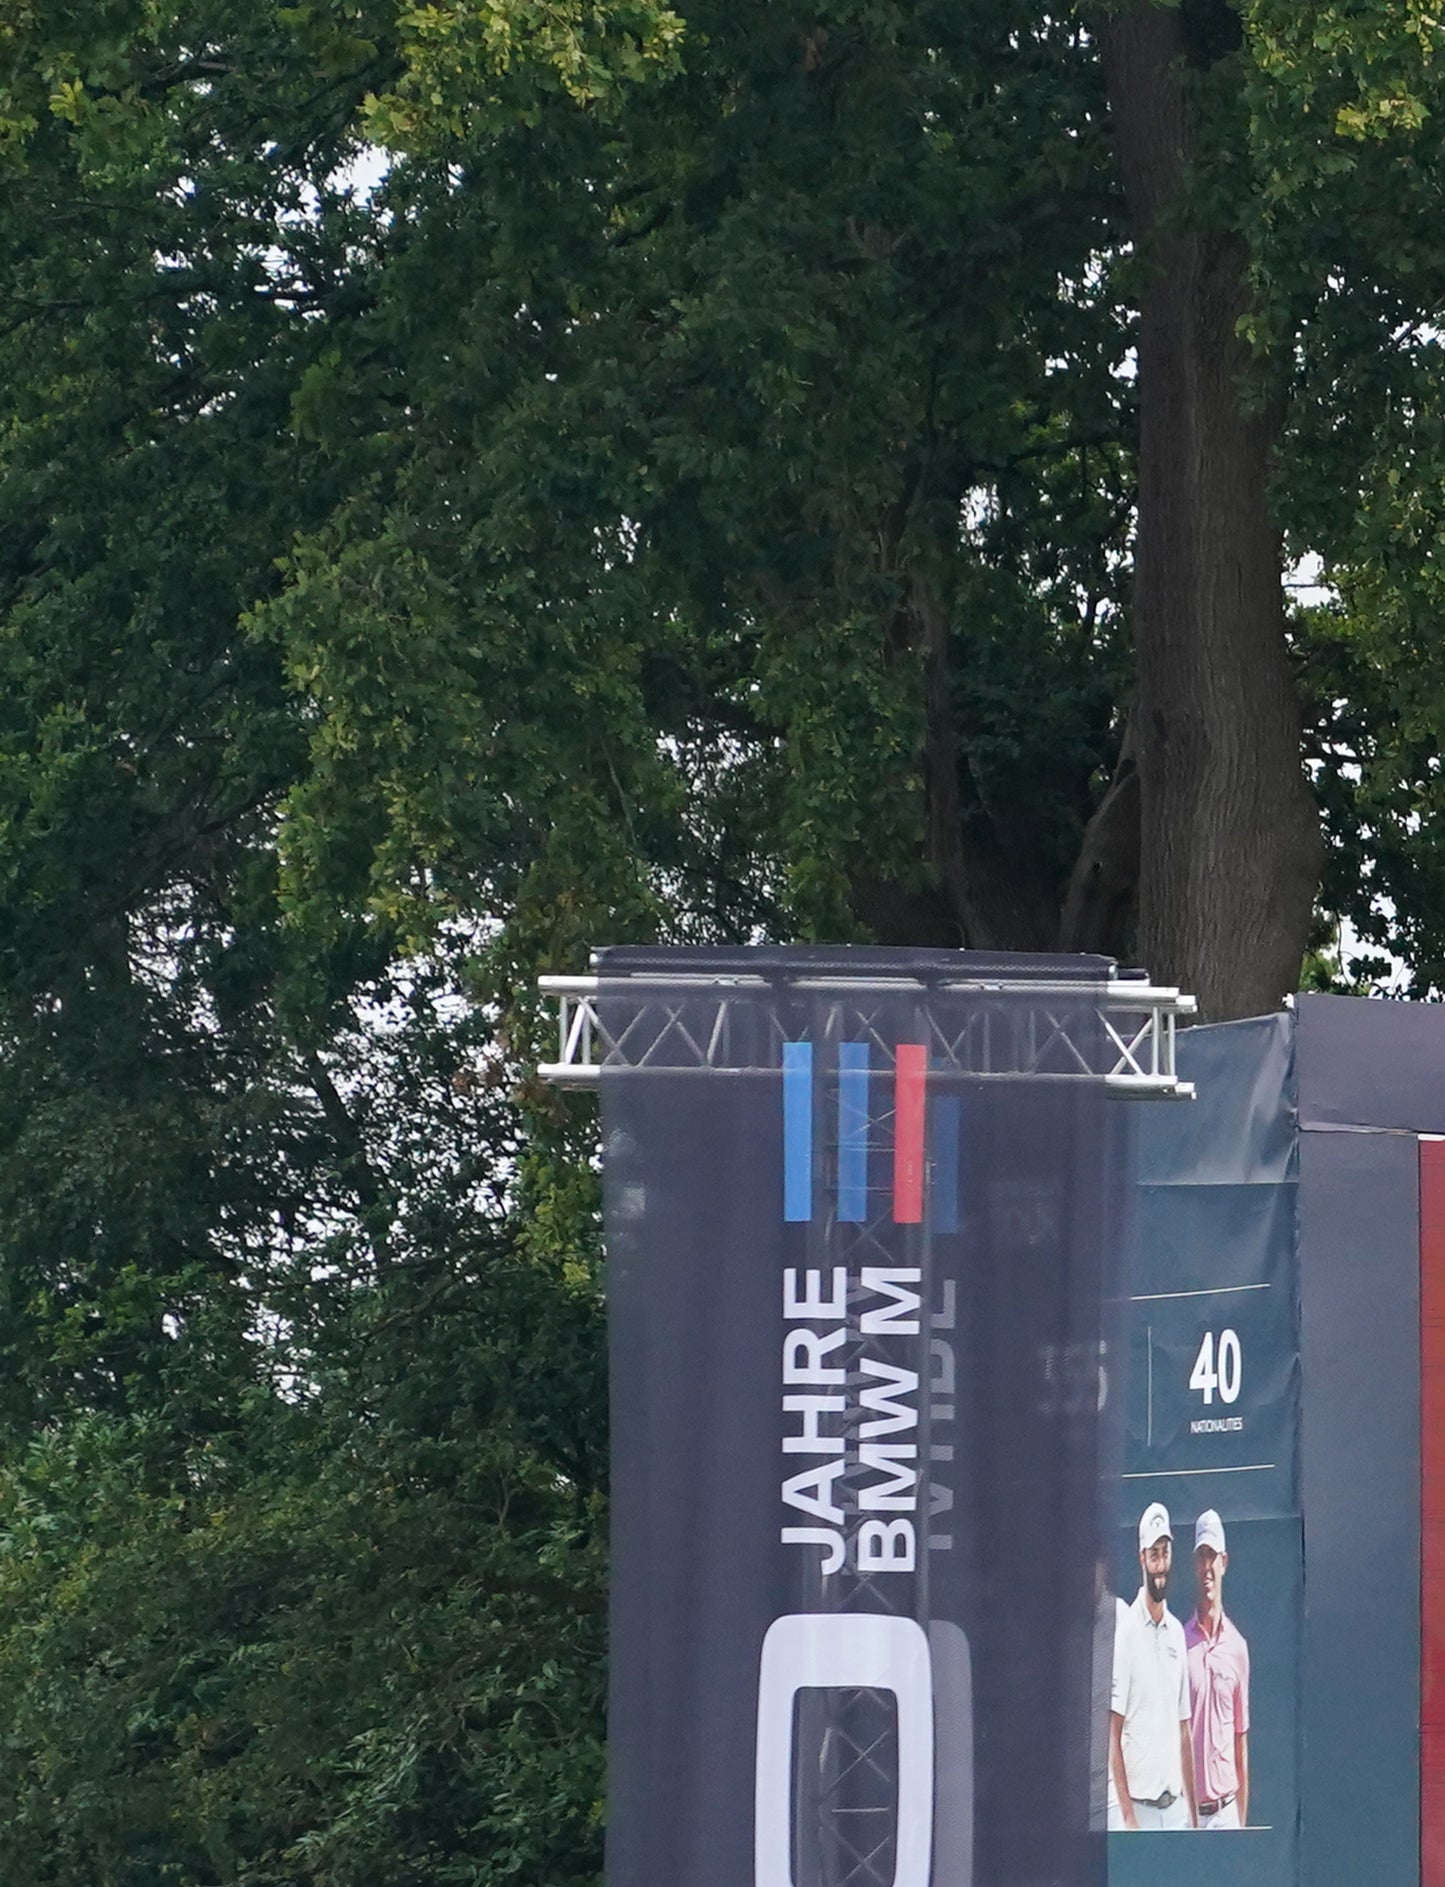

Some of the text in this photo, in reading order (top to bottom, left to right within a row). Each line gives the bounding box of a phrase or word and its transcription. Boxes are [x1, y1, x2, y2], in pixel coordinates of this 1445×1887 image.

[781, 1265, 847, 1576] JAHRE
[857, 1266, 922, 1573] BMW M
[1188, 1328, 1243, 1405] 40
